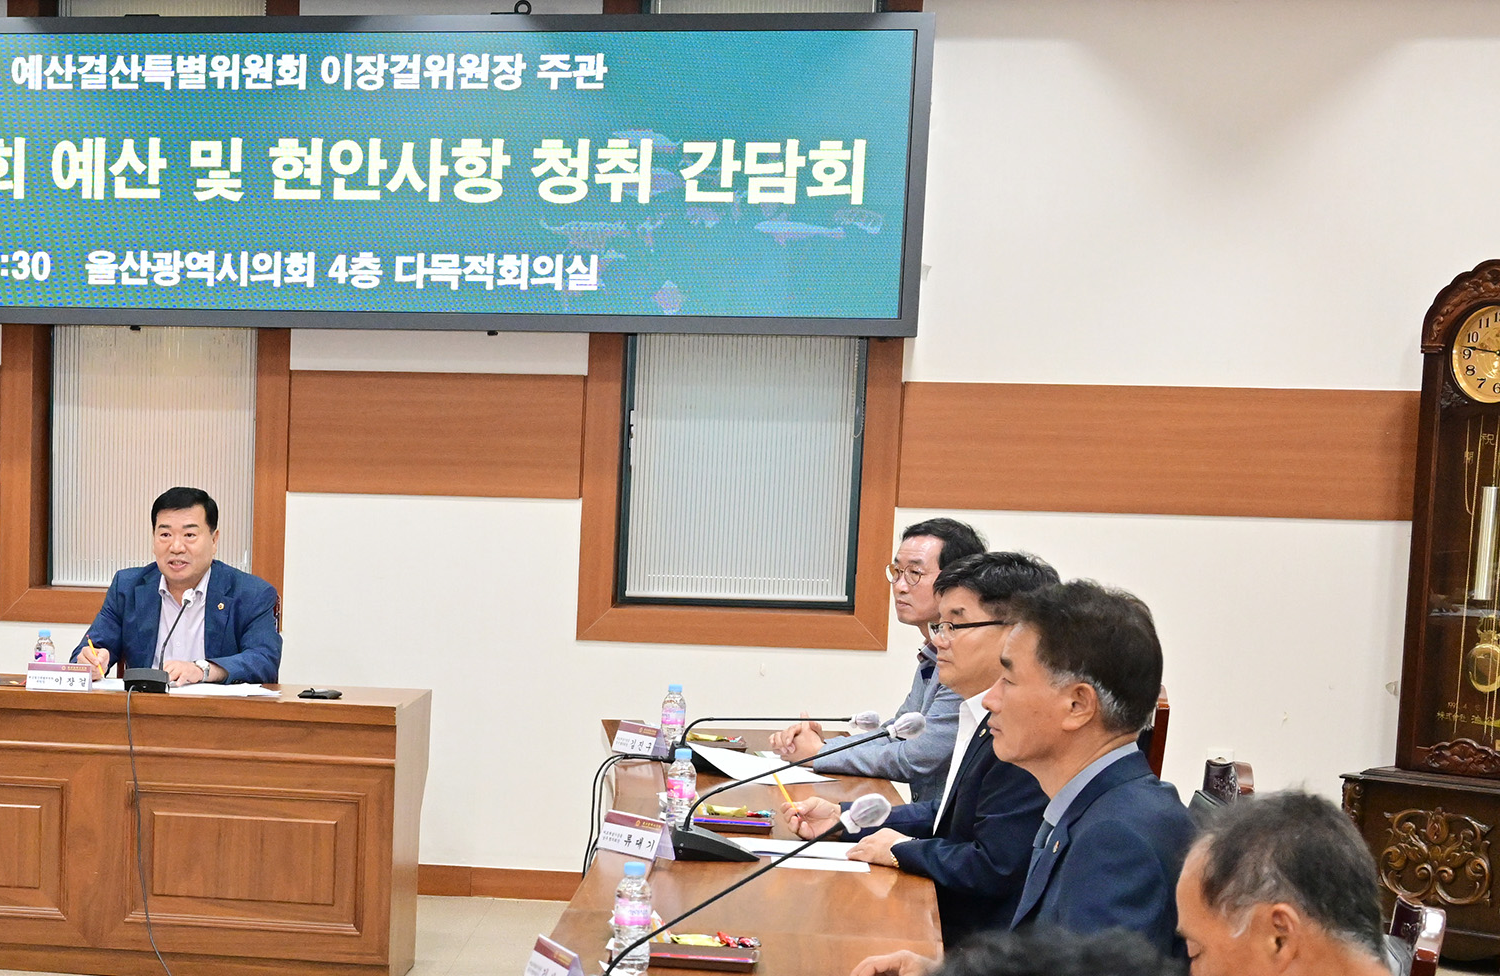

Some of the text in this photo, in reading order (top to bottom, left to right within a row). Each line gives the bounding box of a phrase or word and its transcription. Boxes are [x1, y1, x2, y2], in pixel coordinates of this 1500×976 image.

[11, 53, 307, 91] 예산결산특별위원회
[319, 53, 527, 91] 이장걸위원장
[536, 52, 609, 90] 주관
[50, 136, 168, 200] 예산
[189, 136, 245, 202] 및
[268, 136, 512, 203] 현안사항
[530, 137, 654, 204] 청취
[678, 137, 868, 206] 간담회
[84, 249, 317, 288] 울산광역시의회
[327, 251, 384, 290] 4층
[393, 251, 600, 291] 다목적회의실
[1467, 331, 1479, 343] 10
[1462, 348, 1472, 360] 9
[1465, 364, 1476, 377] 8
[1476, 378, 1487, 389] 7
